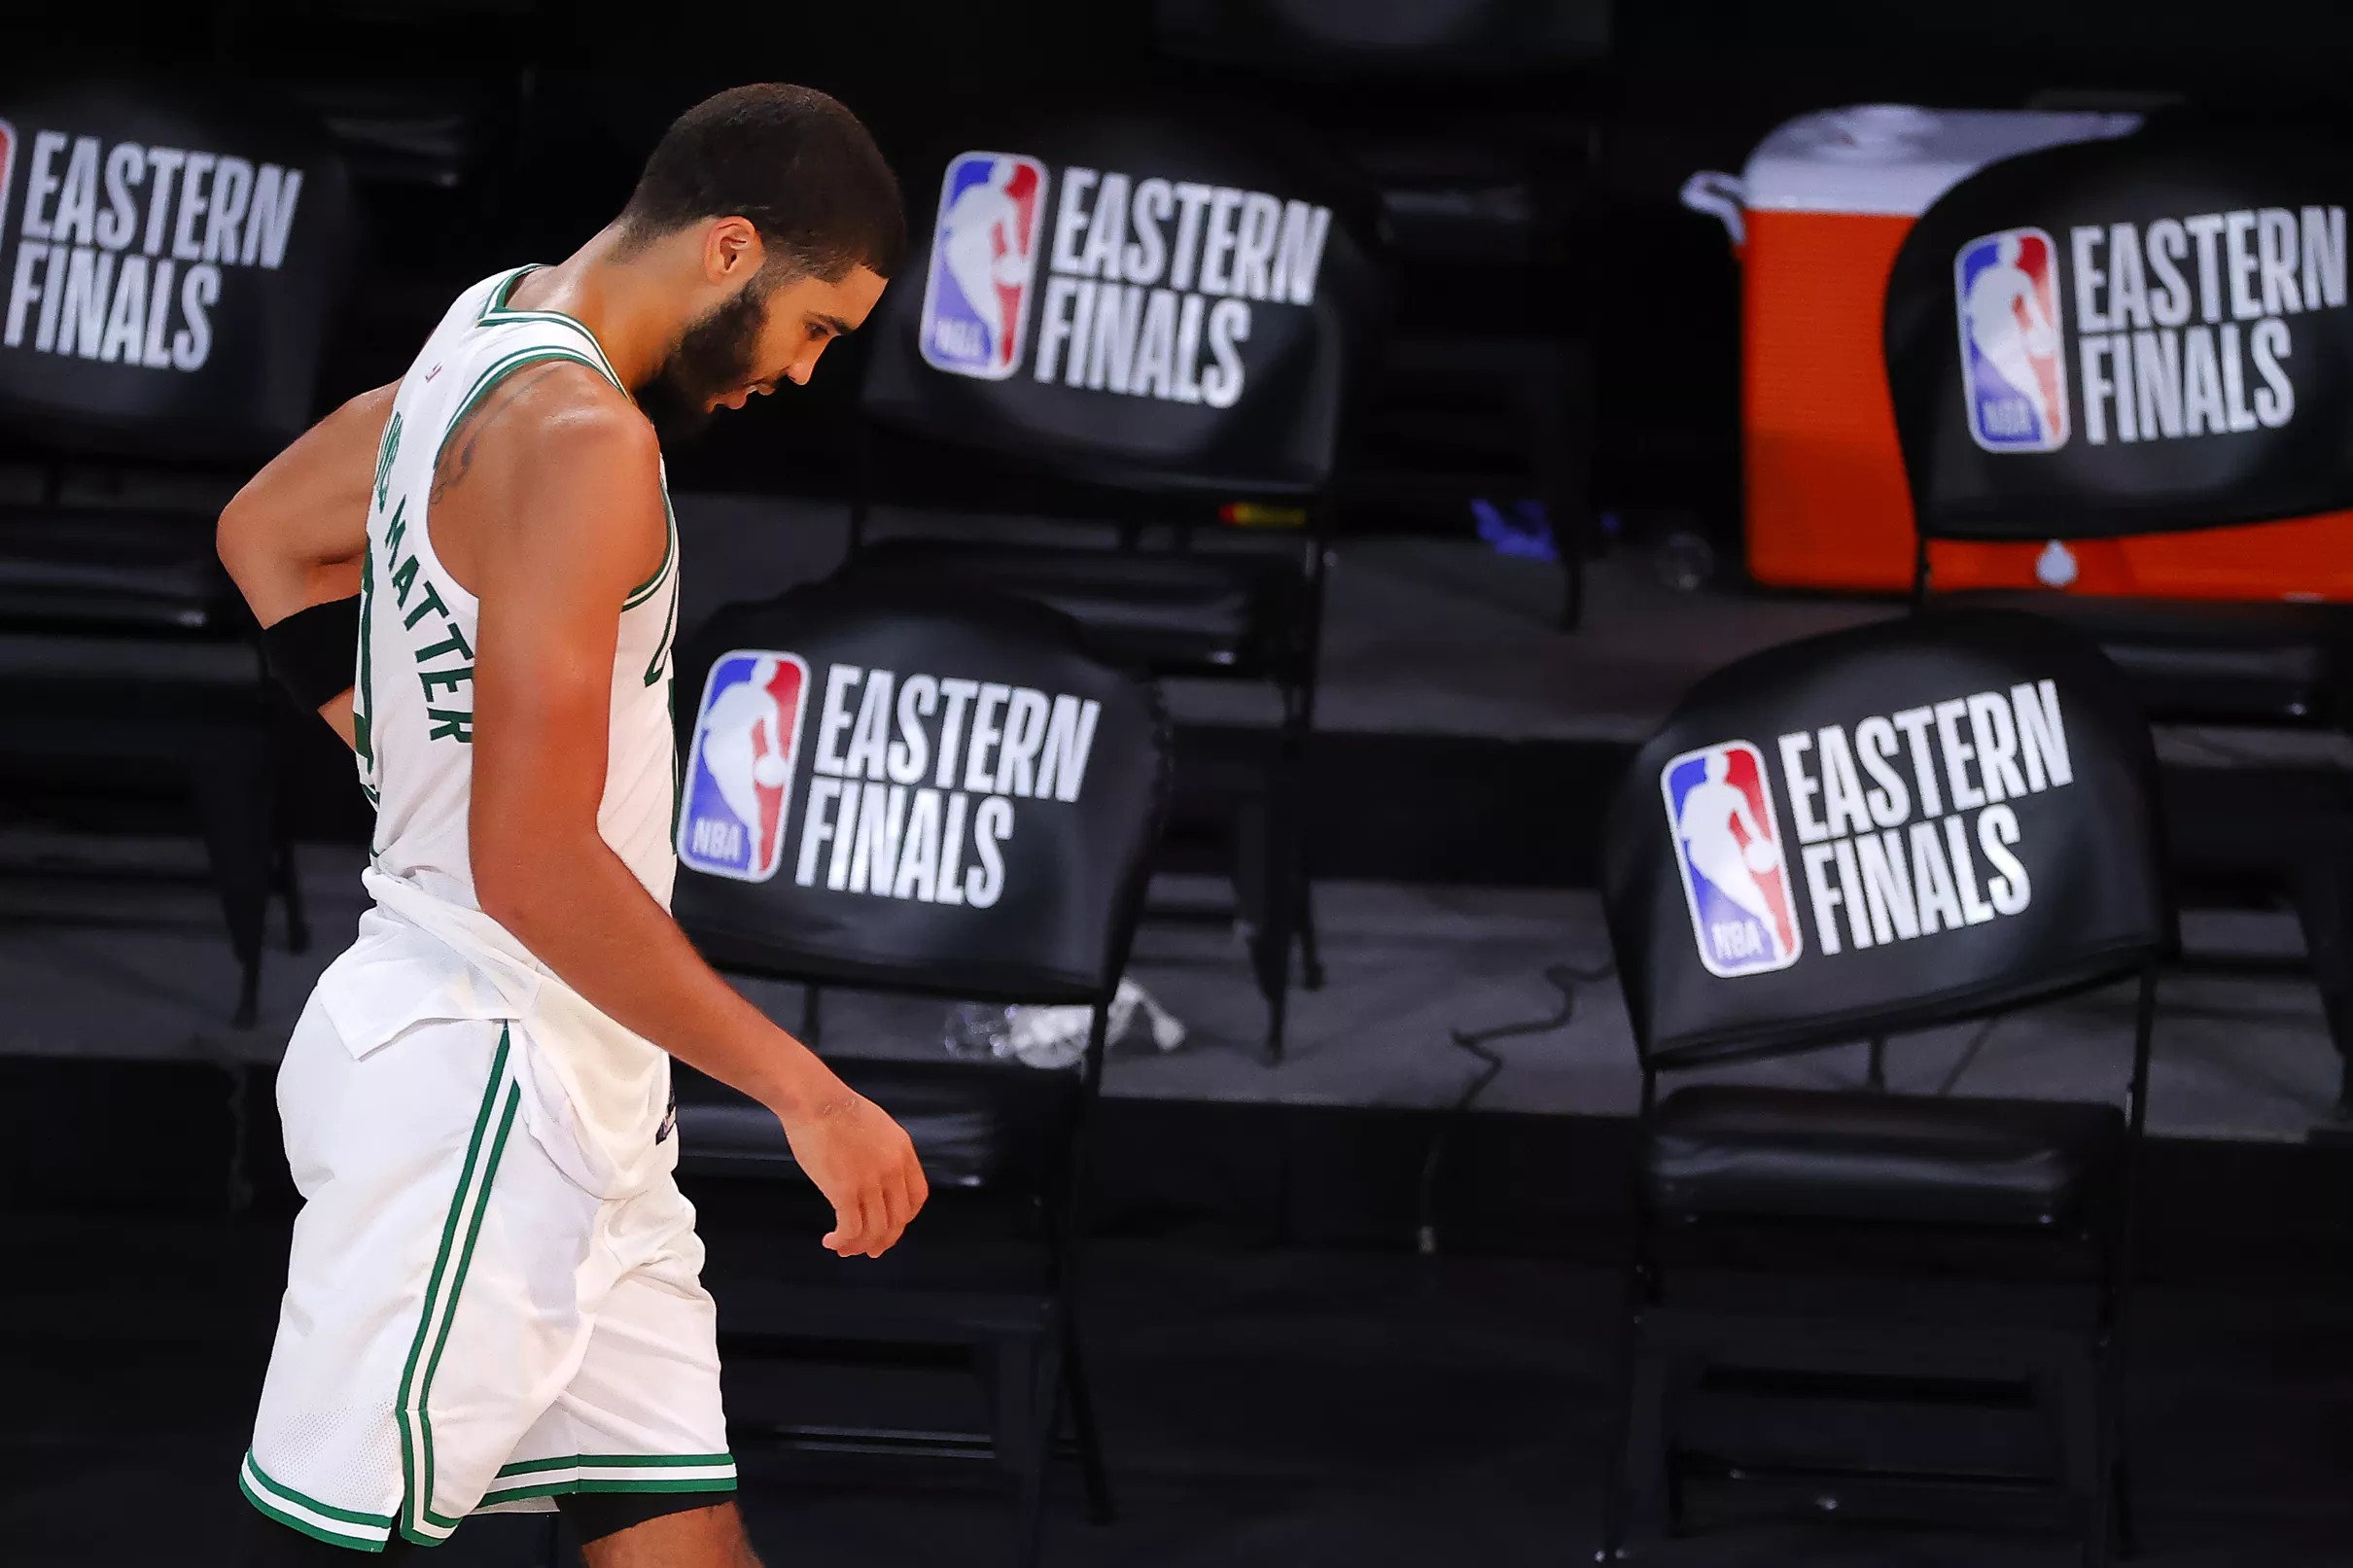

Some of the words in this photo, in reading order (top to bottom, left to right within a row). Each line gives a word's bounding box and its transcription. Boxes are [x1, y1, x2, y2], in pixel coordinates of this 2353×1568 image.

[21, 129, 302, 269] EASTERN
[1050, 166, 1331, 305] EASTERN
[3, 239, 221, 371] FINALS
[2070, 205, 2347, 333] EASTERN
[1035, 275, 1251, 408] FINALS
[2079, 316, 2295, 445] FINALS
[385, 494, 474, 744] MATTER
[813, 663, 1102, 802] EASTERN
[1777, 679, 2074, 845] EASTERN
[692, 817, 742, 861] NBA
[795, 775, 1015, 909] FINALS
[1802, 803, 2031, 956] FINALS
[1711, 921, 1763, 959] NBA
